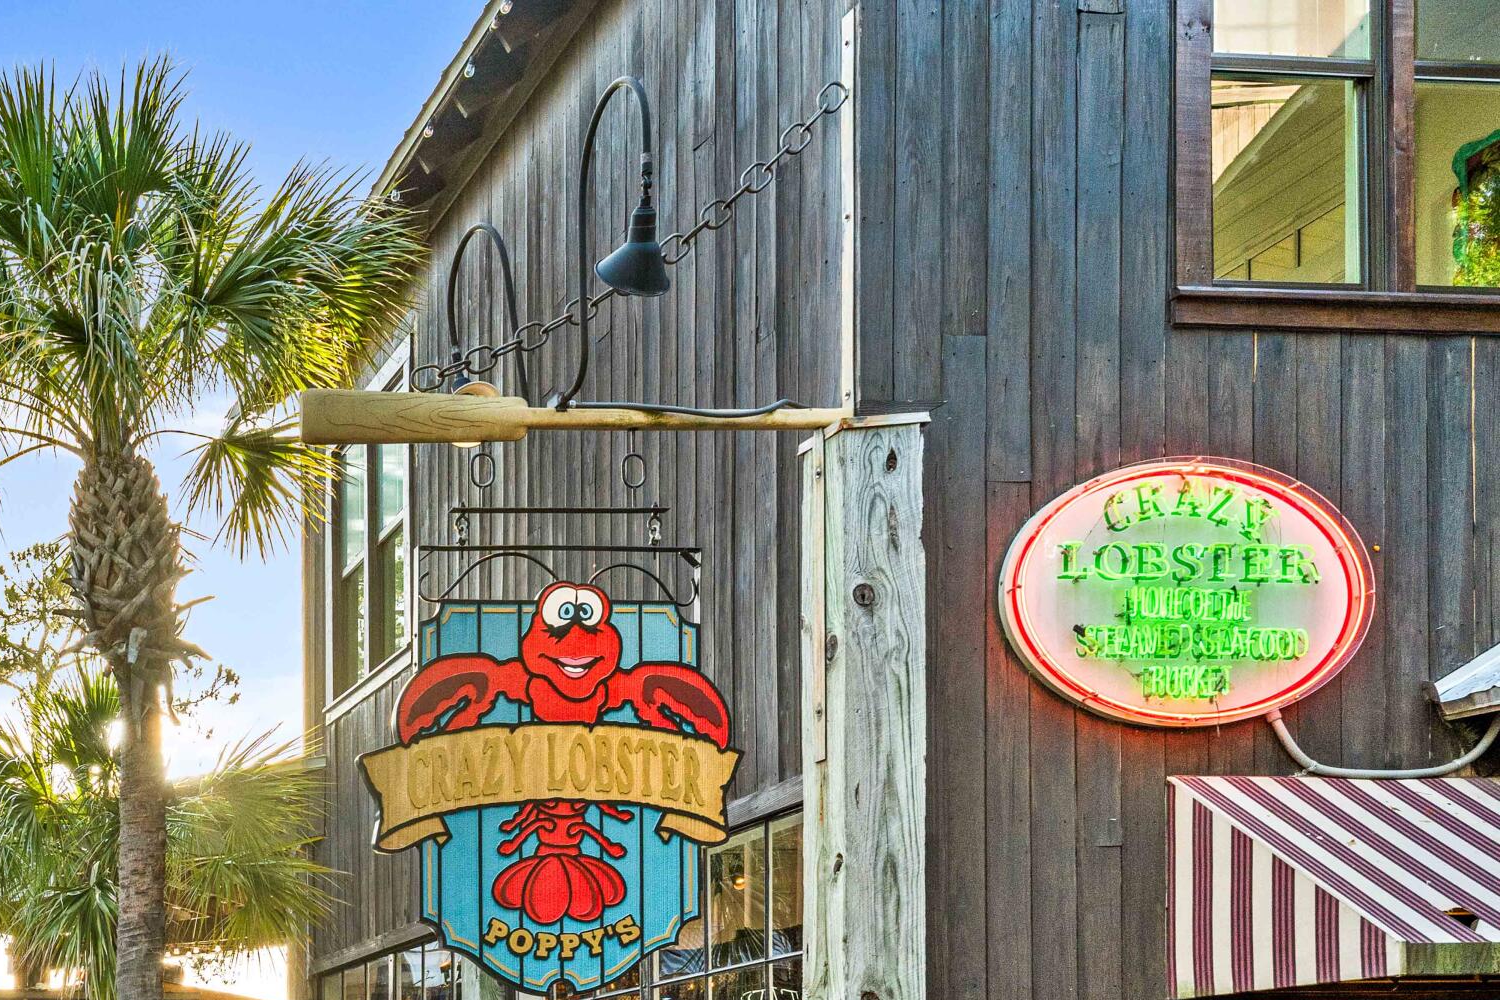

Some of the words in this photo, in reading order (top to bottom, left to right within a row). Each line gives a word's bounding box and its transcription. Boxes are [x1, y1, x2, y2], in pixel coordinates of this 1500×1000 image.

[1104, 477, 1281, 543] CRAZY
[1056, 540, 1322, 584] LOBSTER
[1195, 625, 1309, 659] SEAFOOD
[407, 733, 531, 809] CRAZY
[546, 733, 705, 806] LOBSTER
[484, 915, 641, 960] POPPY'S
